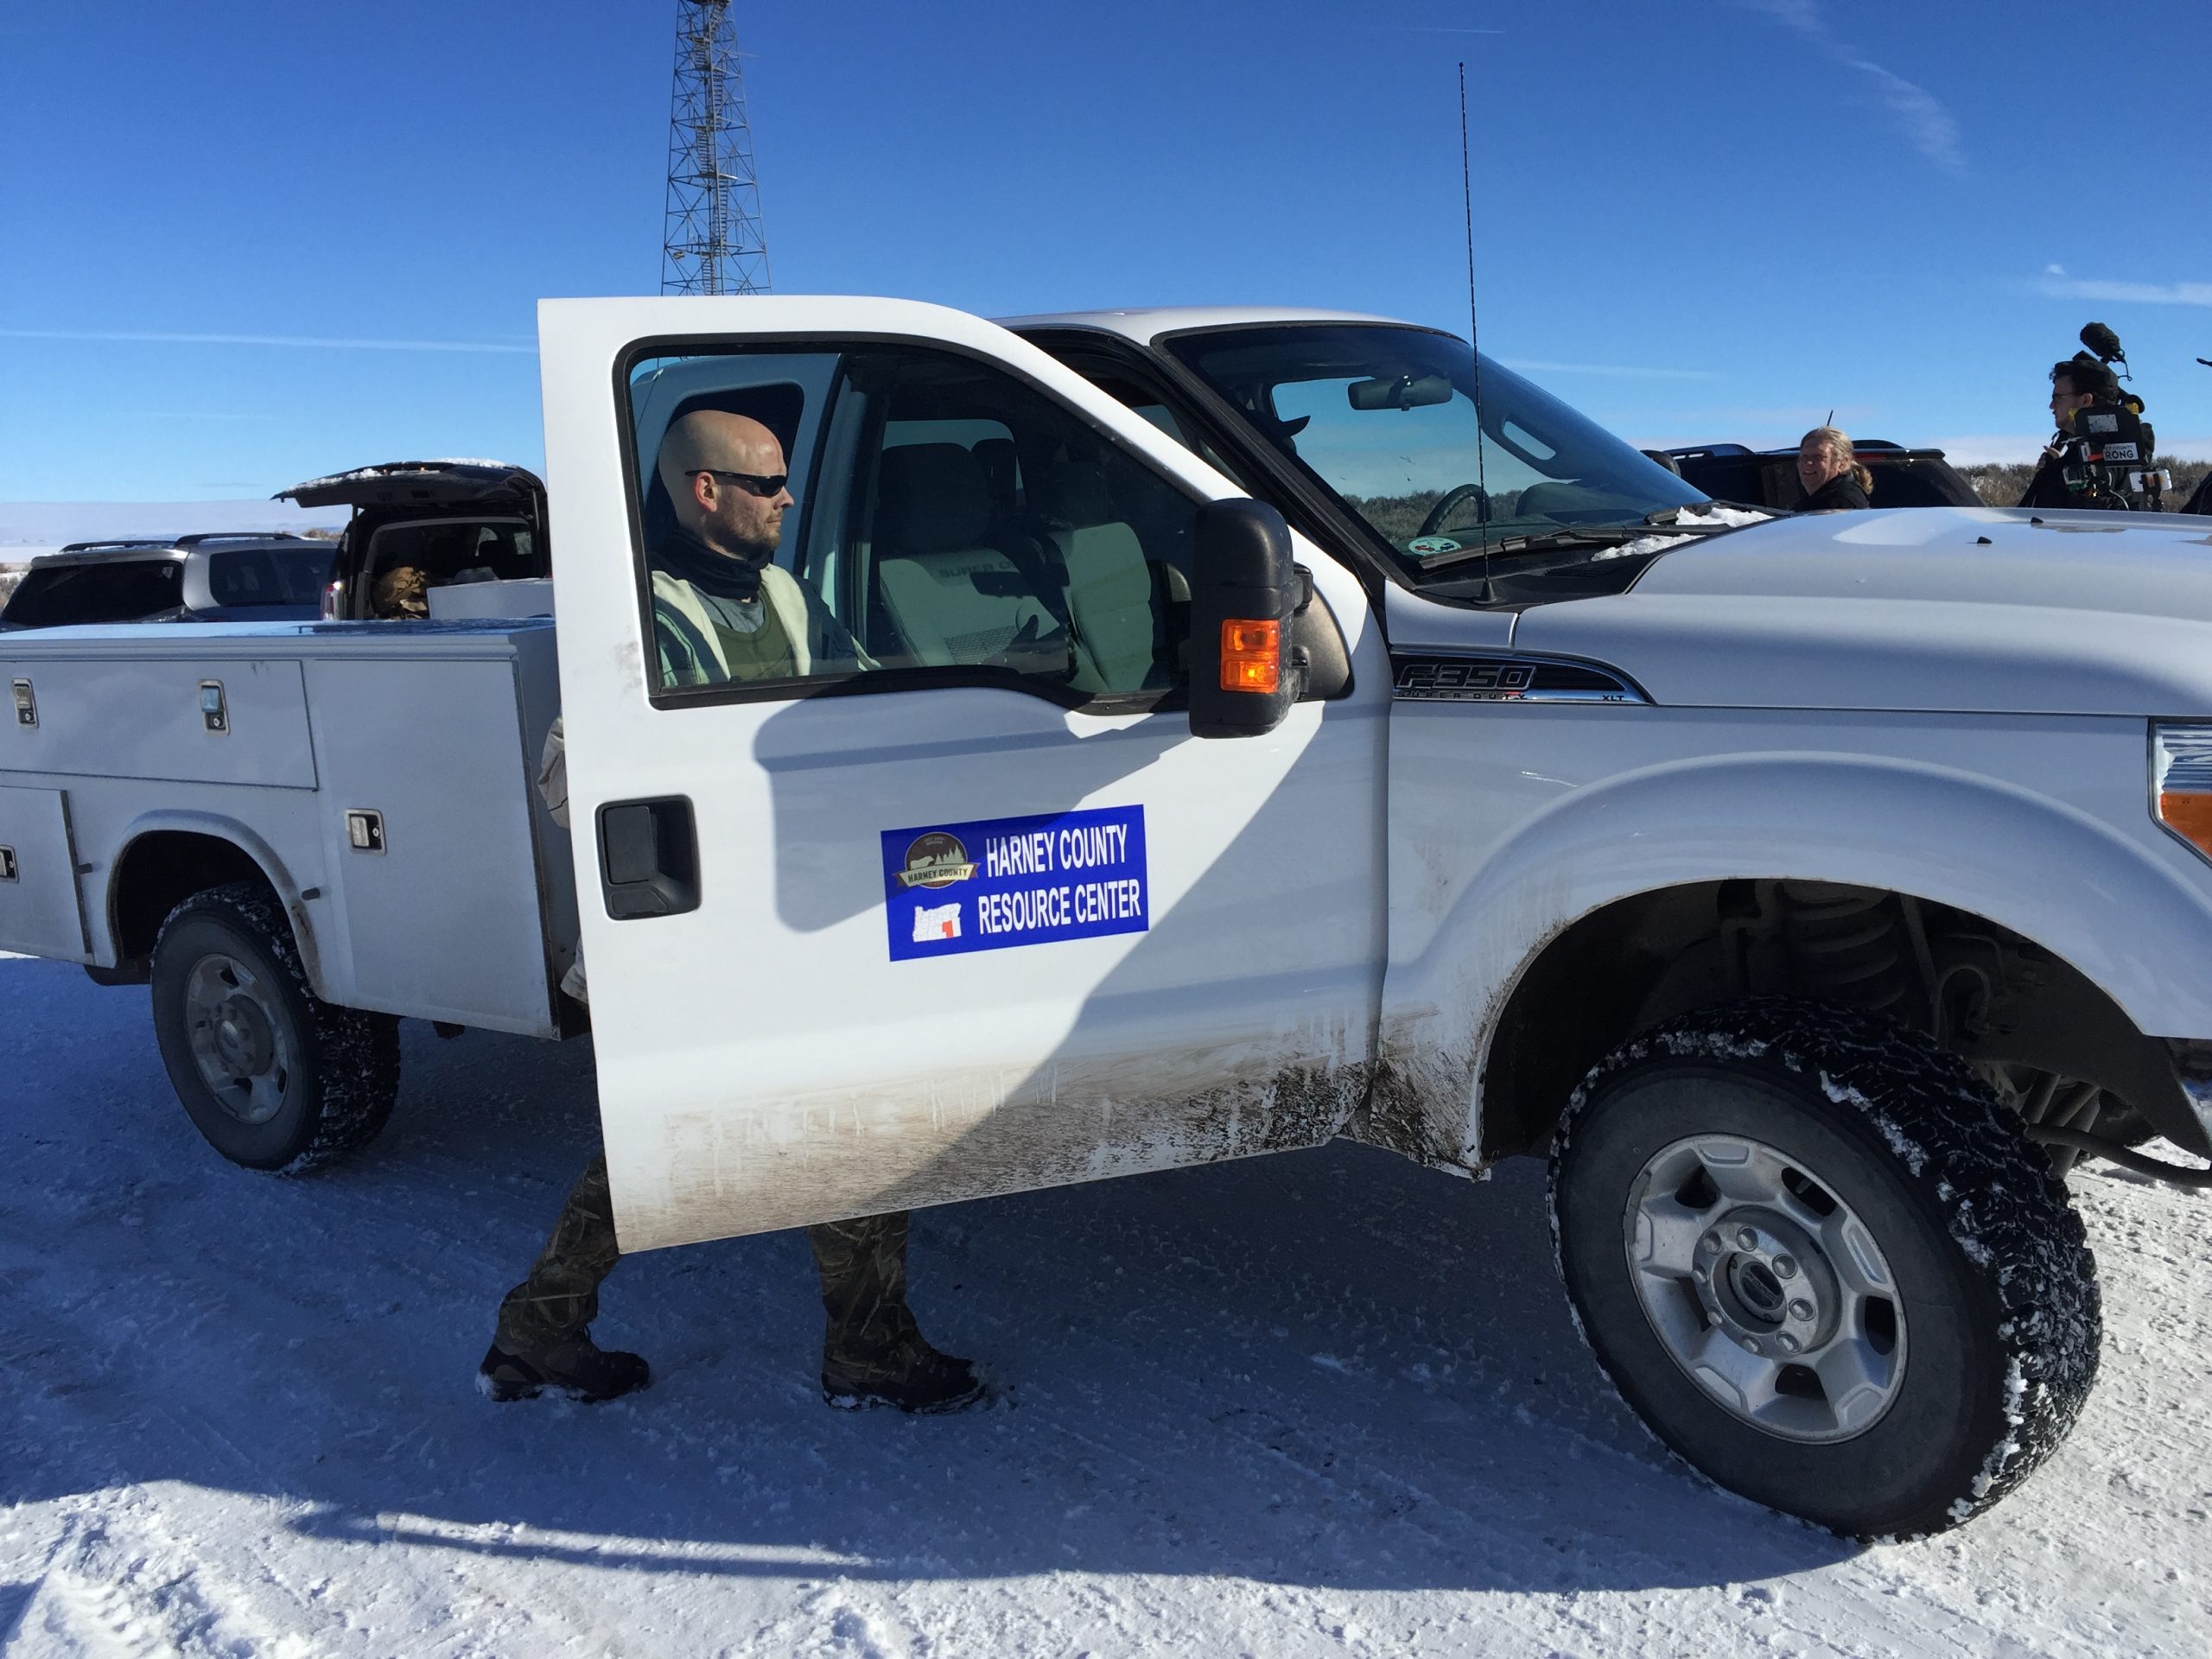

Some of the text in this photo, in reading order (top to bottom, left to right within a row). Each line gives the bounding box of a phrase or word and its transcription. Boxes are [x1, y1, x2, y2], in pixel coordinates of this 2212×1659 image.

[908, 868, 969, 882] HARNEY COUNTY
[985, 823, 1128, 878] HARNEY COUNTY
[978, 879, 1141, 934] RESOURCE CENTER
